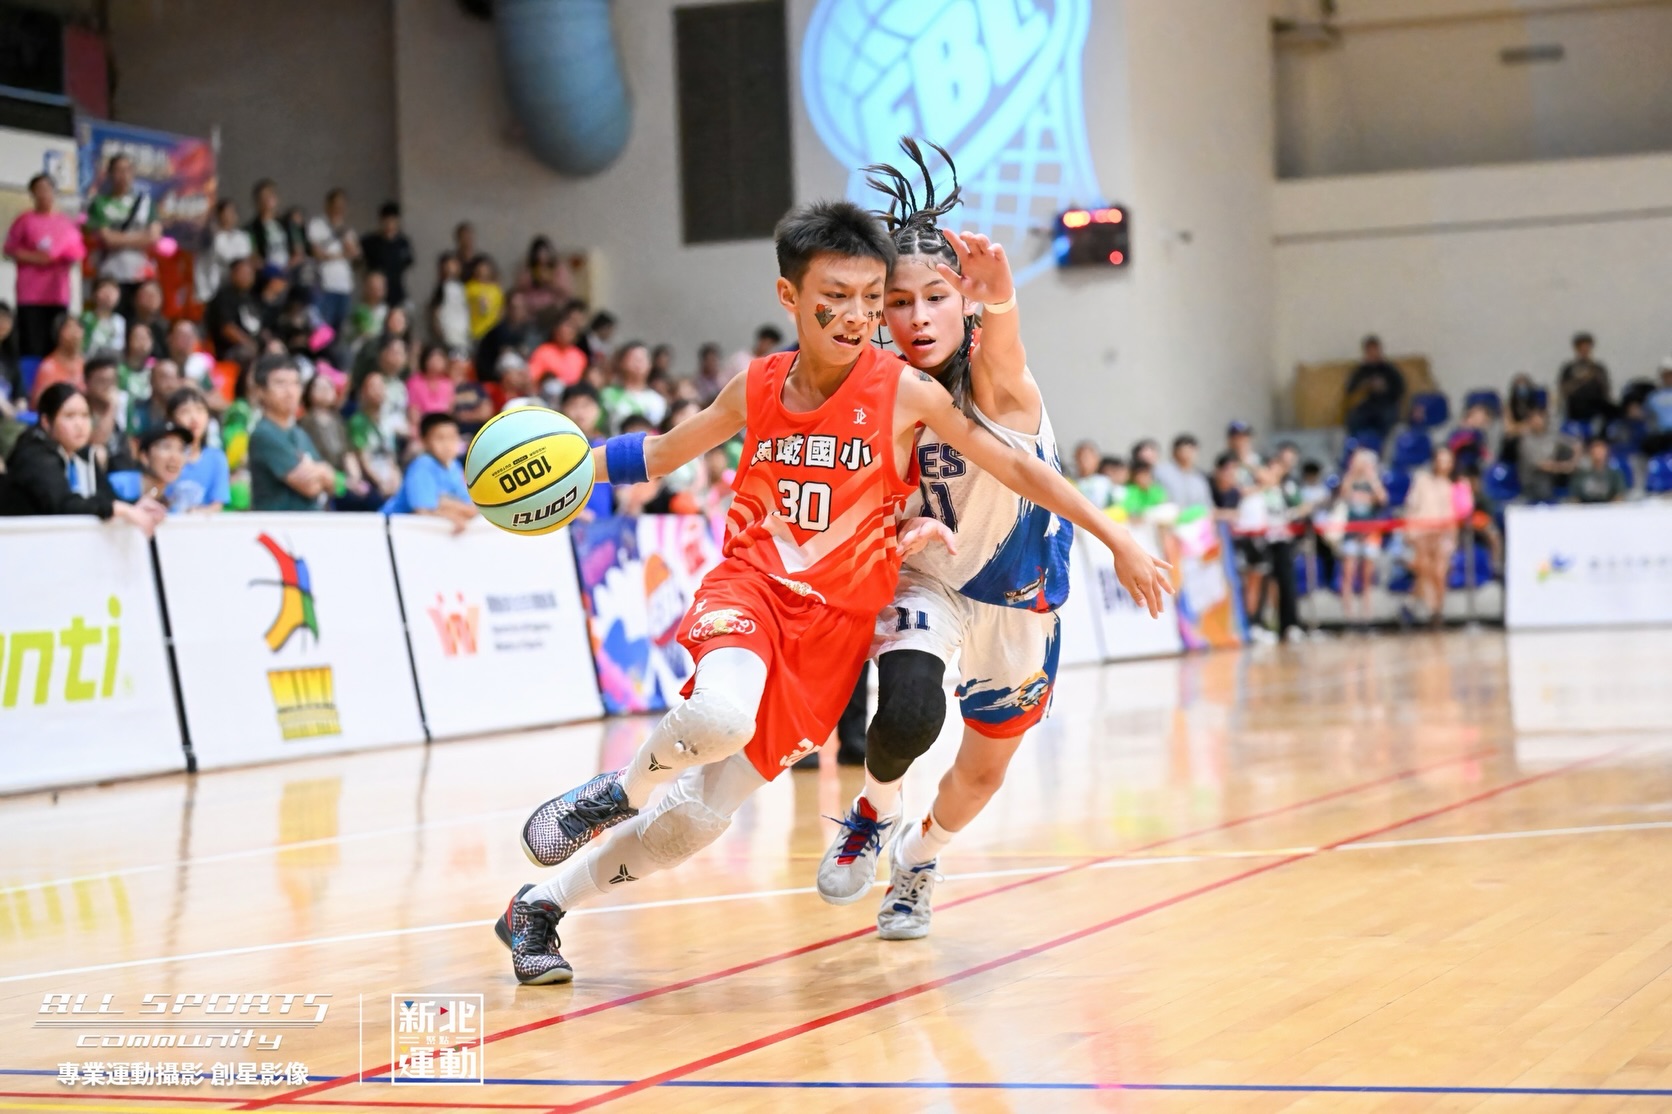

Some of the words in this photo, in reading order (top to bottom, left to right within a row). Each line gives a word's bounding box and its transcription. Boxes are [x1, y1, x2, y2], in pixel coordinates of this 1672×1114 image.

[498, 455, 552, 494] 1000
[771, 478, 832, 532] 30
[895, 606, 931, 632] 11
[0, 594, 122, 709] nti
